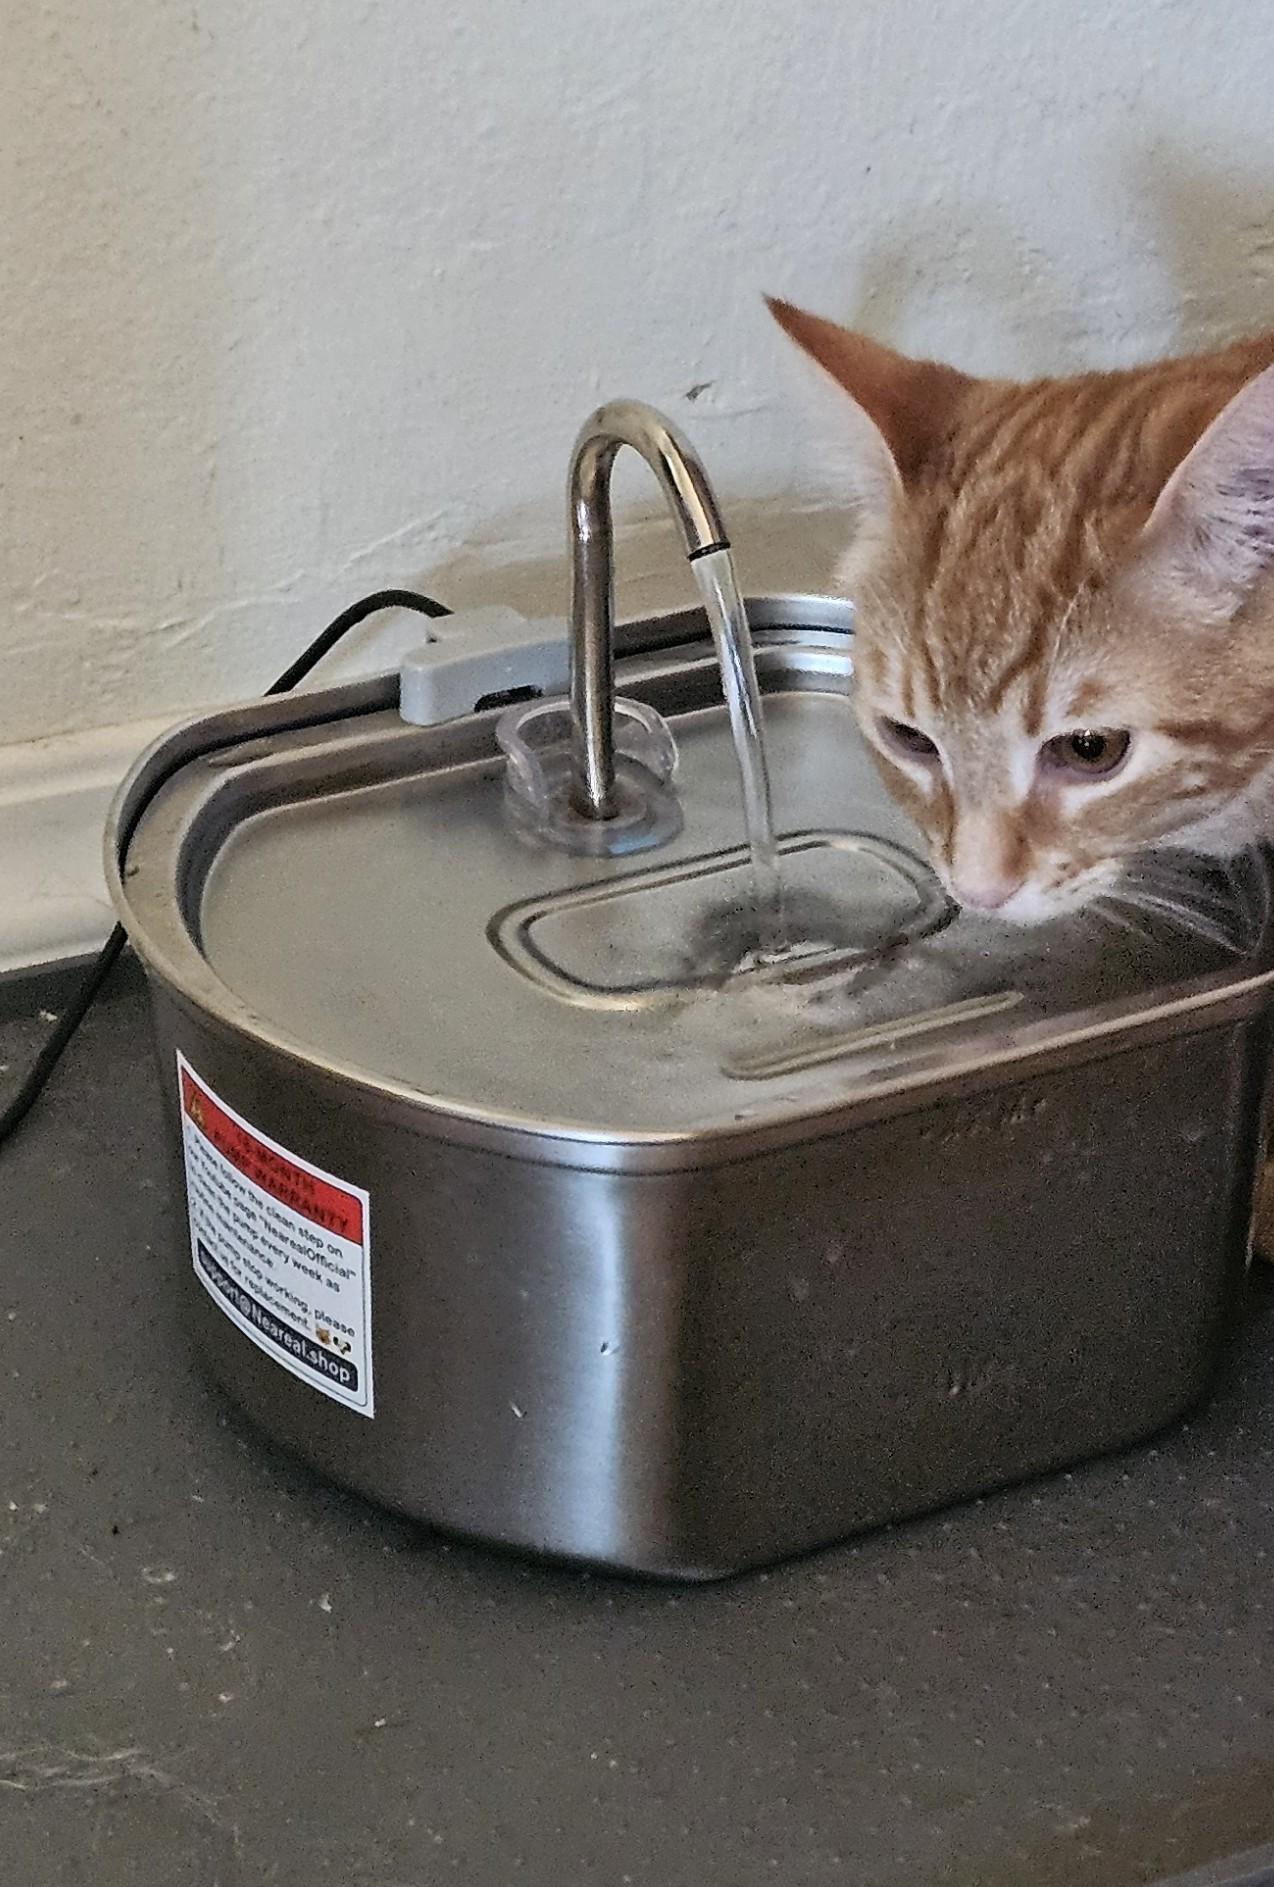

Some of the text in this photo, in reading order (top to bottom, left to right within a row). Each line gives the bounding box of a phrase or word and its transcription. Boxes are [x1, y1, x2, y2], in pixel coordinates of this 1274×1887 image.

[247, 1187, 263, 1211] the
[265, 1201, 295, 1234] clean
[297, 1224, 324, 1251] step
[326, 1242, 343, 1258] on
[253, 1159, 348, 1235] WARRANTY
[232, 1208, 259, 1245] pump
[259, 1232, 290, 1268] every
[291, 1254, 322, 1285] week
[325, 1277, 340, 1293] as
[241, 1252, 263, 1284] stop
[265, 1271, 312, 1318] working,
[314, 1306, 355, 1339] please
